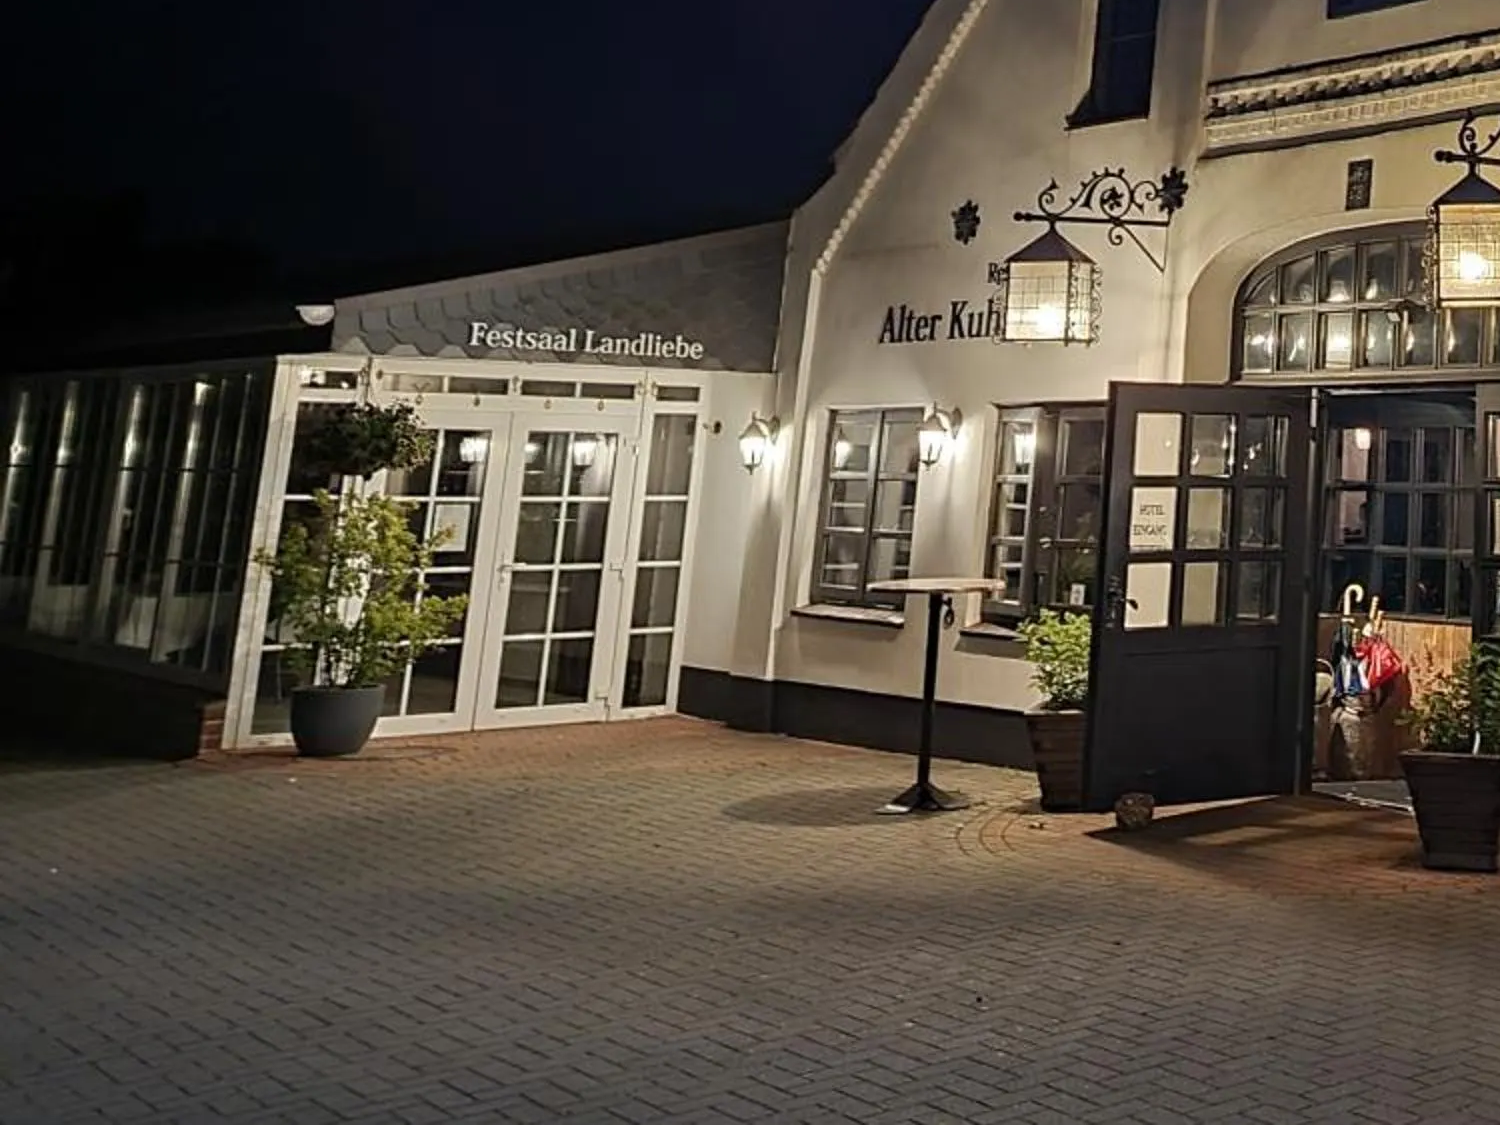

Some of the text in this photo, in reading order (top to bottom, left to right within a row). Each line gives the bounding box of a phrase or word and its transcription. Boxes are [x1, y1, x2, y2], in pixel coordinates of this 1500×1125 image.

[469, 322, 704, 360] Festsaal Landliebe
[878, 303, 943, 345] Alter
